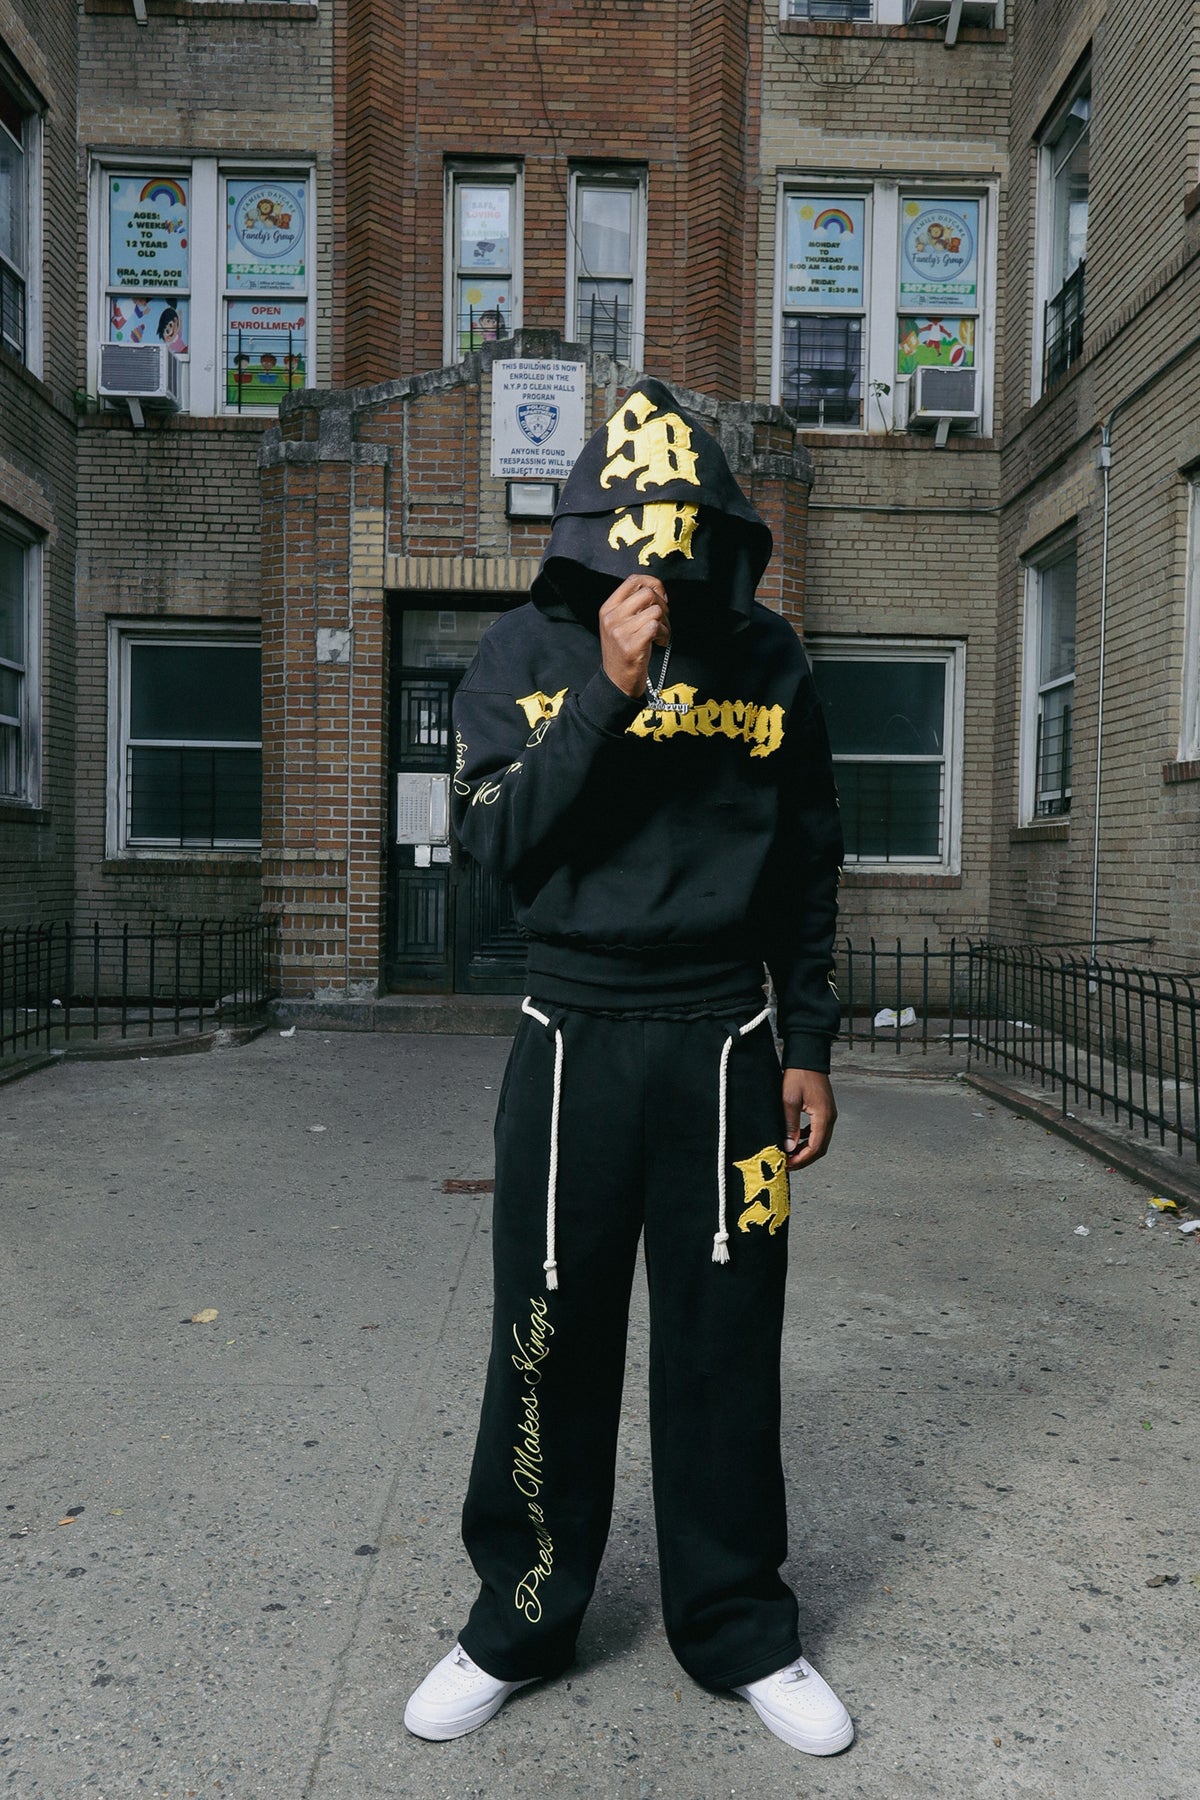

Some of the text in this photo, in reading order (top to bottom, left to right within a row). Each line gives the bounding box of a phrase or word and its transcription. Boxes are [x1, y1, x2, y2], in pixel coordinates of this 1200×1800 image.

[242, 191, 296, 213] FAMILY DAYCARE
[133, 212, 160, 220] AGES:
[136, 222, 166, 230] WEEKS
[141, 231, 153, 239] TO
[272, 230, 294, 243] Group
[126, 240, 138, 248] 12
[138, 250, 156, 258] OLD
[140, 269, 161, 278] ACS,
[142, 279, 178, 287] PRIVATE
[252, 306, 281, 315] OPEN
[230, 321, 301, 330] ENROLLMENT
[561, 364, 577, 372] NOW
[554, 384, 575, 392] HALLS
[548, 458, 564, 466] WILL
[546, 468, 571, 476] ARRES
[511, 1296, 554, 1385] Kings
[513, 1387, 543, 1497] Makes
